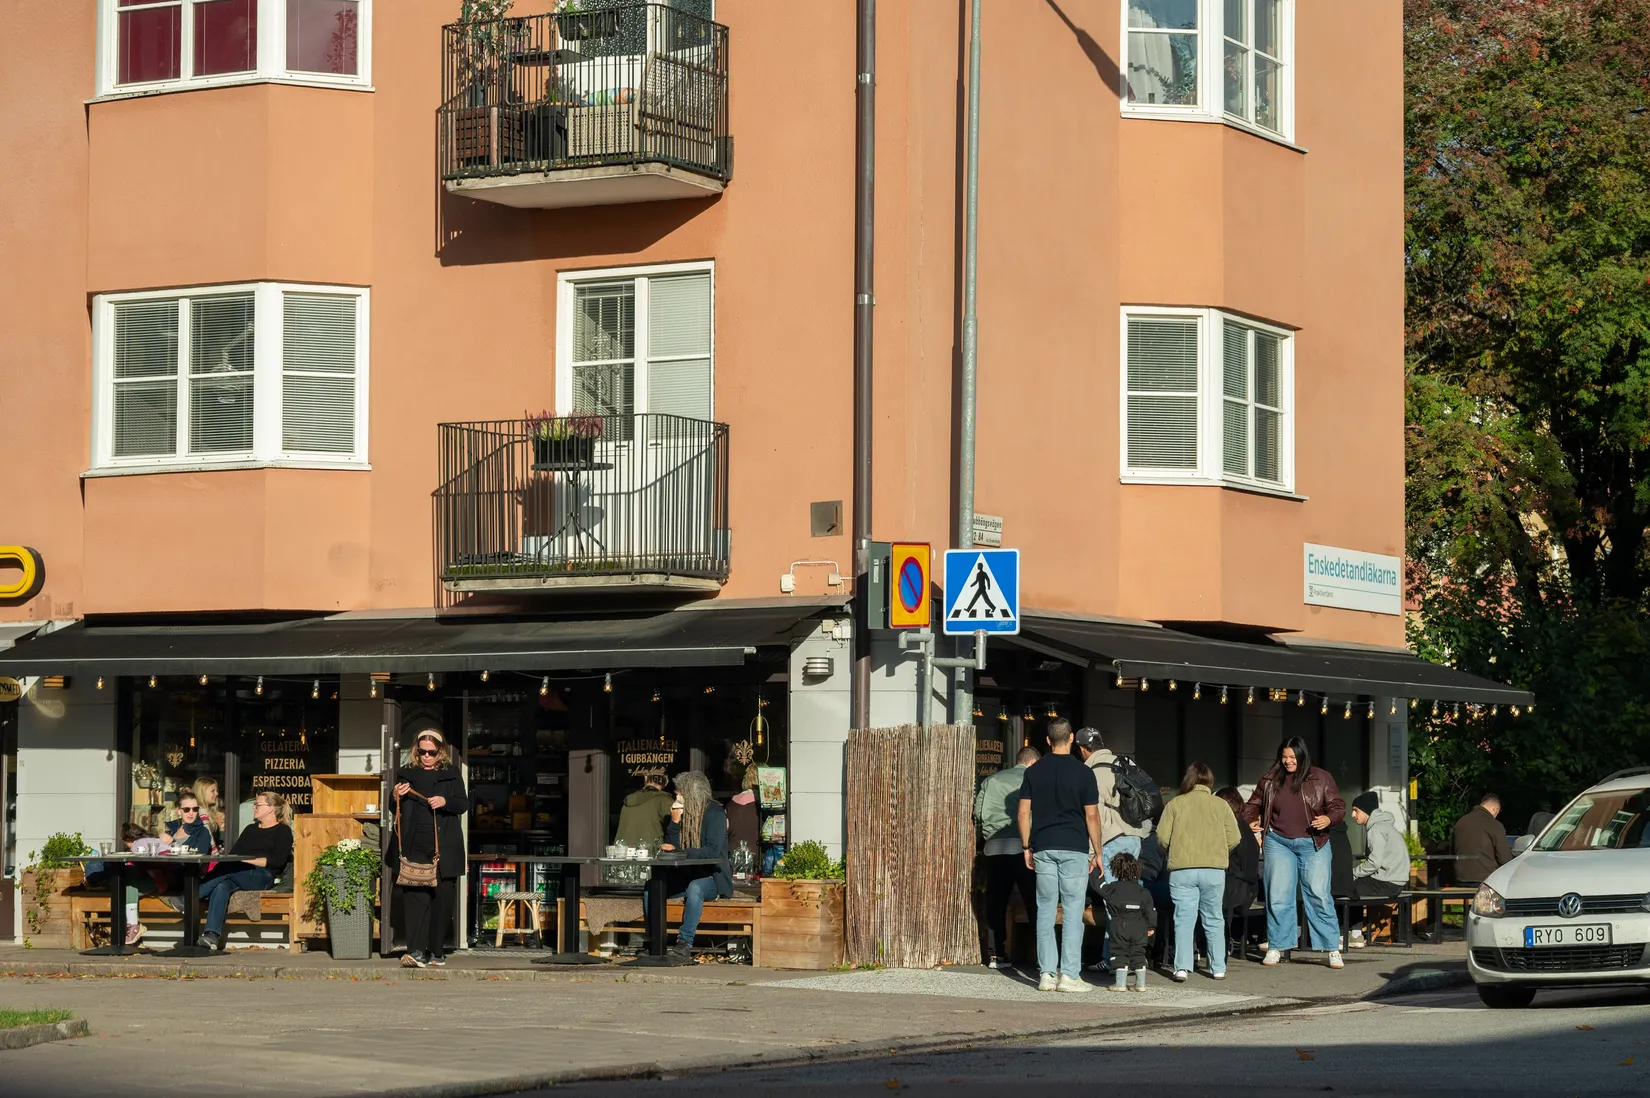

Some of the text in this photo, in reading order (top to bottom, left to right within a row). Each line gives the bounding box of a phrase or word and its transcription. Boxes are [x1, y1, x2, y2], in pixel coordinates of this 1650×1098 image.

[1308, 553, 1397, 586] Enskedetandläkarna
[260, 740, 310, 752] GELATERIA
[264, 758, 306, 770] PIZZERIA
[621, 752, 674, 764] I GUBBÄNGEN
[252, 775, 313, 787] ESPRESSOBA
[1575, 927, 1605, 942] 609
